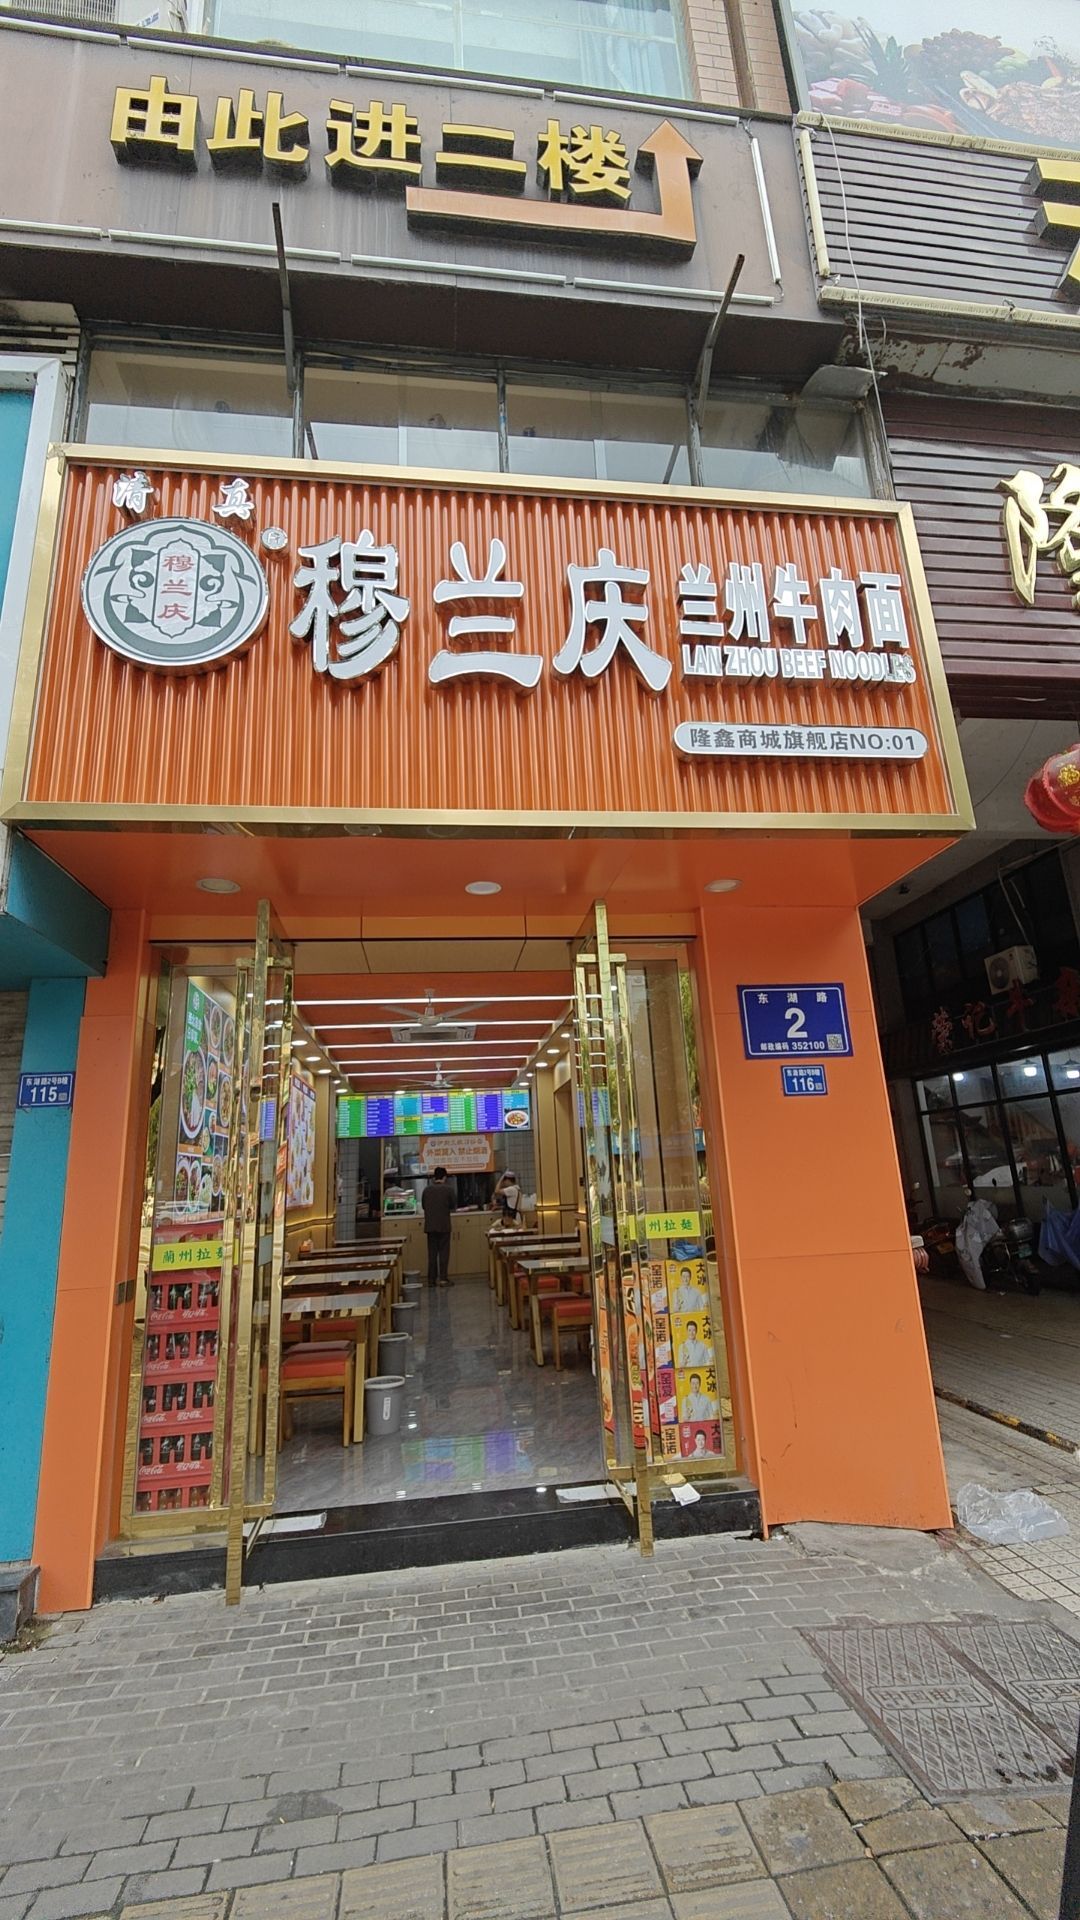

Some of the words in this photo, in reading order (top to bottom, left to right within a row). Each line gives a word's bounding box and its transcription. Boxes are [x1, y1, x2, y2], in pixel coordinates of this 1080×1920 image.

[110, 75, 630, 198] 由此进二楼
[112, 470, 254, 520] 清真
[157, 554, 194, 621] 穆兰庆
[288, 528, 672, 692] 穆兰庆
[678, 562, 910, 649] 兰州牛肉面
[682, 644, 723, 677] LAN
[724, 645, 779, 679] ZHOU
[780, 648, 826, 680] BEEF
[828, 650, 916, 684] NOODLES
[690, 728, 915, 751] 隆鑫商城旗舰店NO:01
[757, 992, 827, 1004] 东湖路
[785, 1007, 808, 1038] 2
[792, 1041, 825, 1050] 352100
[31, 1087, 57, 1102] 115
[792, 1078, 815, 1091] 116
